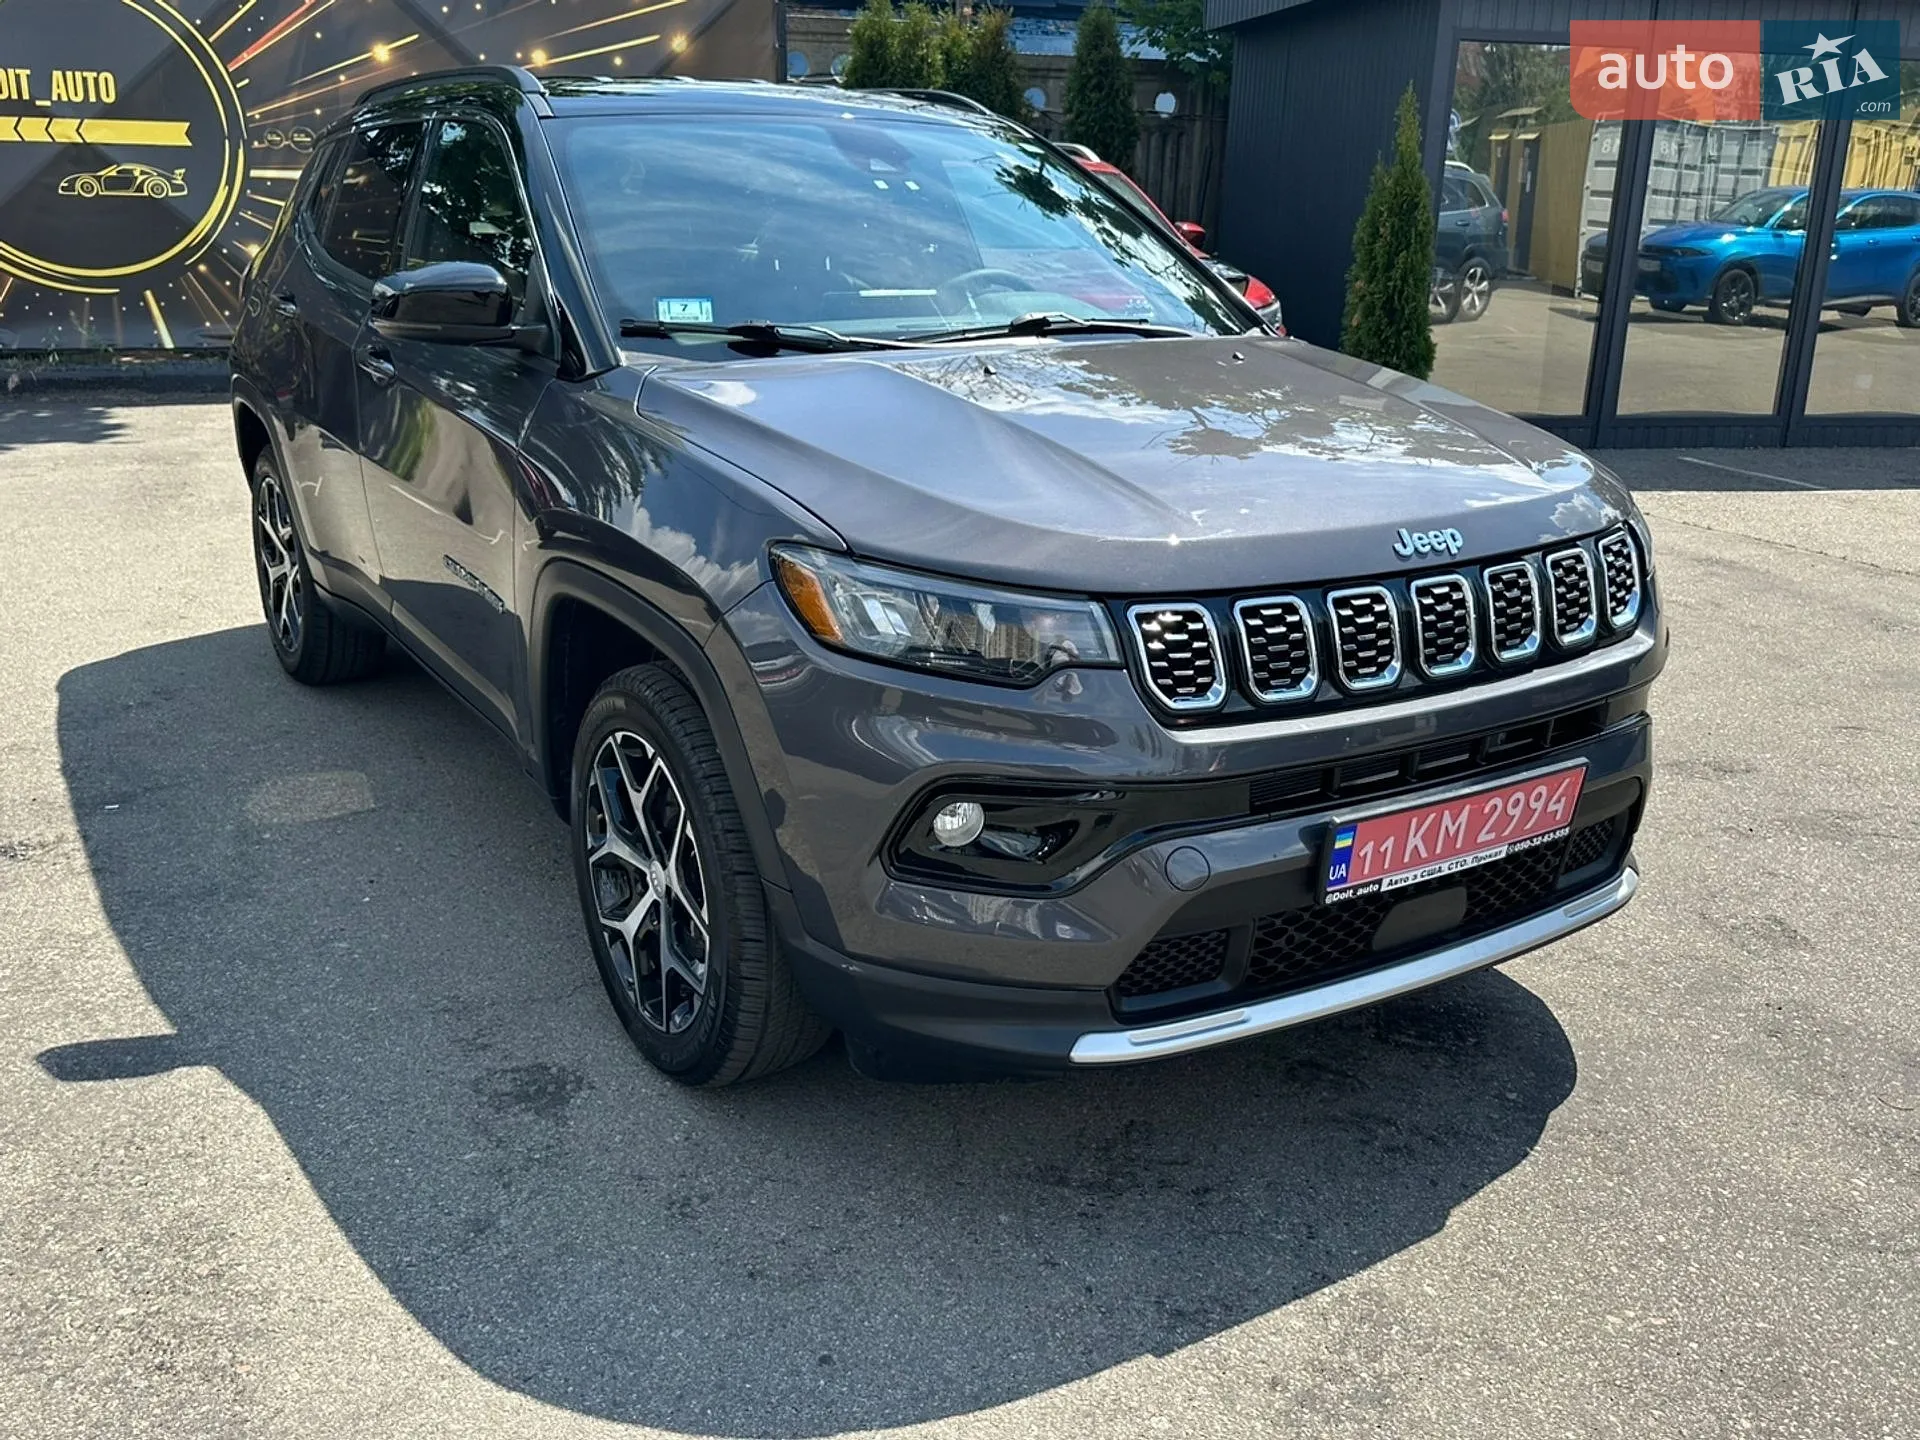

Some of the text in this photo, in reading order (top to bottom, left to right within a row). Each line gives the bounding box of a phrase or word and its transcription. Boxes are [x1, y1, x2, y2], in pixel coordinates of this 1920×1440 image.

[1393, 527, 1463, 557] Jeep
[1358, 836, 1395, 875] 11
[1476, 776, 1572, 844] 2994
[1329, 863, 1347, 881] UA
[1387, 876, 1409, 888] Авто
